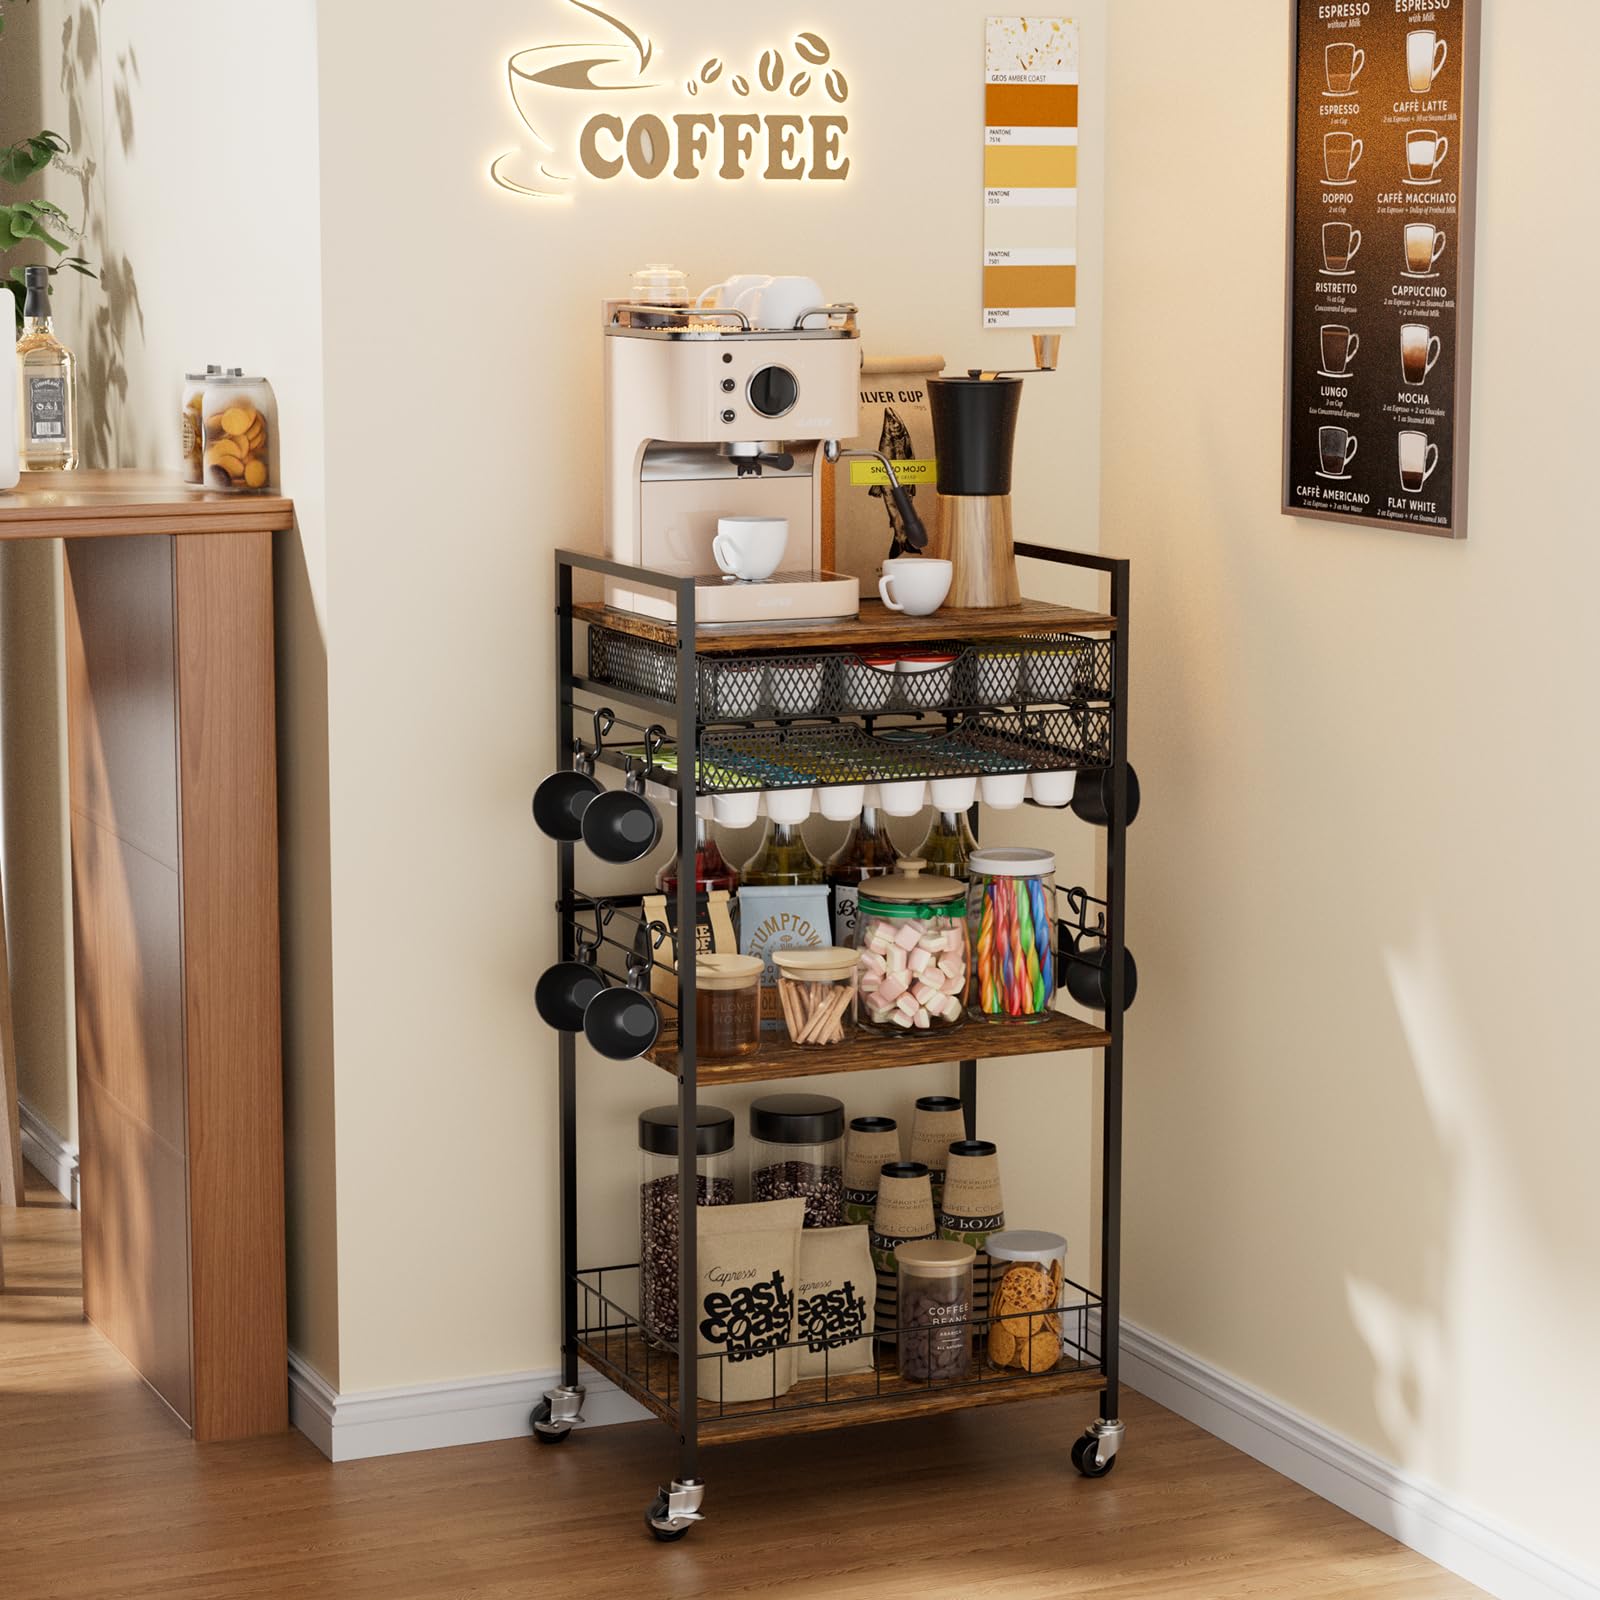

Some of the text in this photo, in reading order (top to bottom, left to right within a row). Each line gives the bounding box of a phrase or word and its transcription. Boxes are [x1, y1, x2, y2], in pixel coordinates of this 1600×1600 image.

[1319, 3, 1370, 18] ESPRESSO
[1395, 0, 1450, 13] ESPRESSO
[1327, 18, 1361, 29] without Milk
[1409, 12, 1435, 23] with Milk
[1028, 75, 1046, 83] COAST
[1320, 104, 1360, 116] ESPRESSO
[1393, 99, 1448, 113] CAFFÈ LATTE
[580, 113, 850, 180] COFFEE
[1322, 193, 1354, 204] DOPPIO
[1377, 191, 1457, 204] CAFFÈ MACCHIATO
[1315, 282, 1358, 294] RISTRETTO
[1392, 285, 1447, 297] CAPPUCCINO
[860, 391, 923, 403] ILVER CUP
[1320, 386, 1348, 398] LUNGO
[1398, 392, 1430, 405] MOCHA
[1296, 485, 1370, 504] CAFFÈ AMERICANO
[1388, 497, 1436, 513] FLAT WHITE
[748, 913, 822, 957] TUMPTOW
[704, 1266, 757, 1287] Capresso
[704, 1269, 788, 1318] east
[799, 1279, 832, 1295] apresso
[928, 1302, 969, 1316] COFFEE
[932, 1314, 967, 1325] BEANS
[726, 1320, 791, 1363] blend
[808, 1321, 862, 1353] blend
